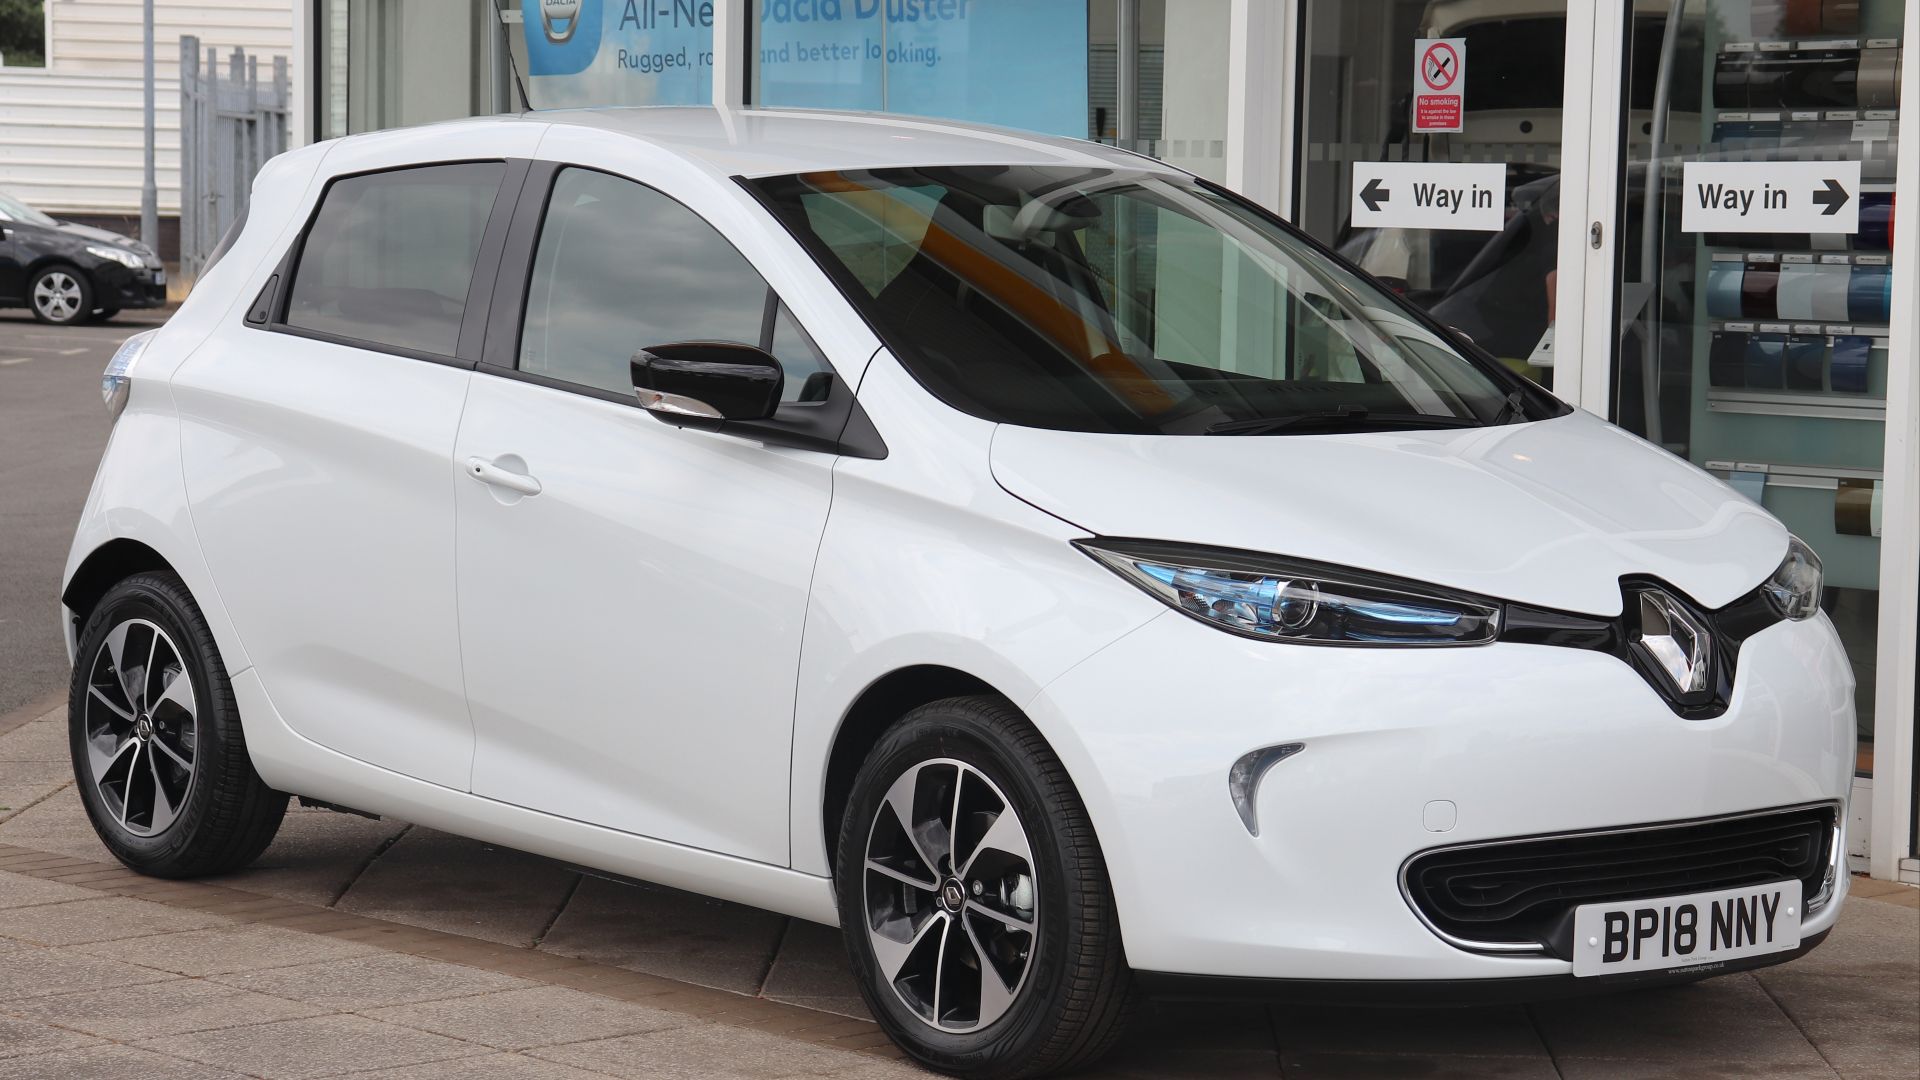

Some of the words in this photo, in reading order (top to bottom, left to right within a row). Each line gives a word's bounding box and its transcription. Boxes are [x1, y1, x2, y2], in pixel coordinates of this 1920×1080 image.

[618, 0, 713, 31] All-Ne
[856, 0, 968, 23] Duster
[617, 47, 692, 74] Rugged,
[796, 40, 860, 63] better
[1419, 97, 1429, 106] No
[1430, 97, 1458, 107] smoking
[1413, 183, 1464, 215] Way
[1471, 183, 1493, 209] in
[1697, 183, 1755, 216] Way
[1763, 183, 1788, 209] in
[1603, 904, 1698, 963] BP18
[1710, 892, 1781, 951] NNY
